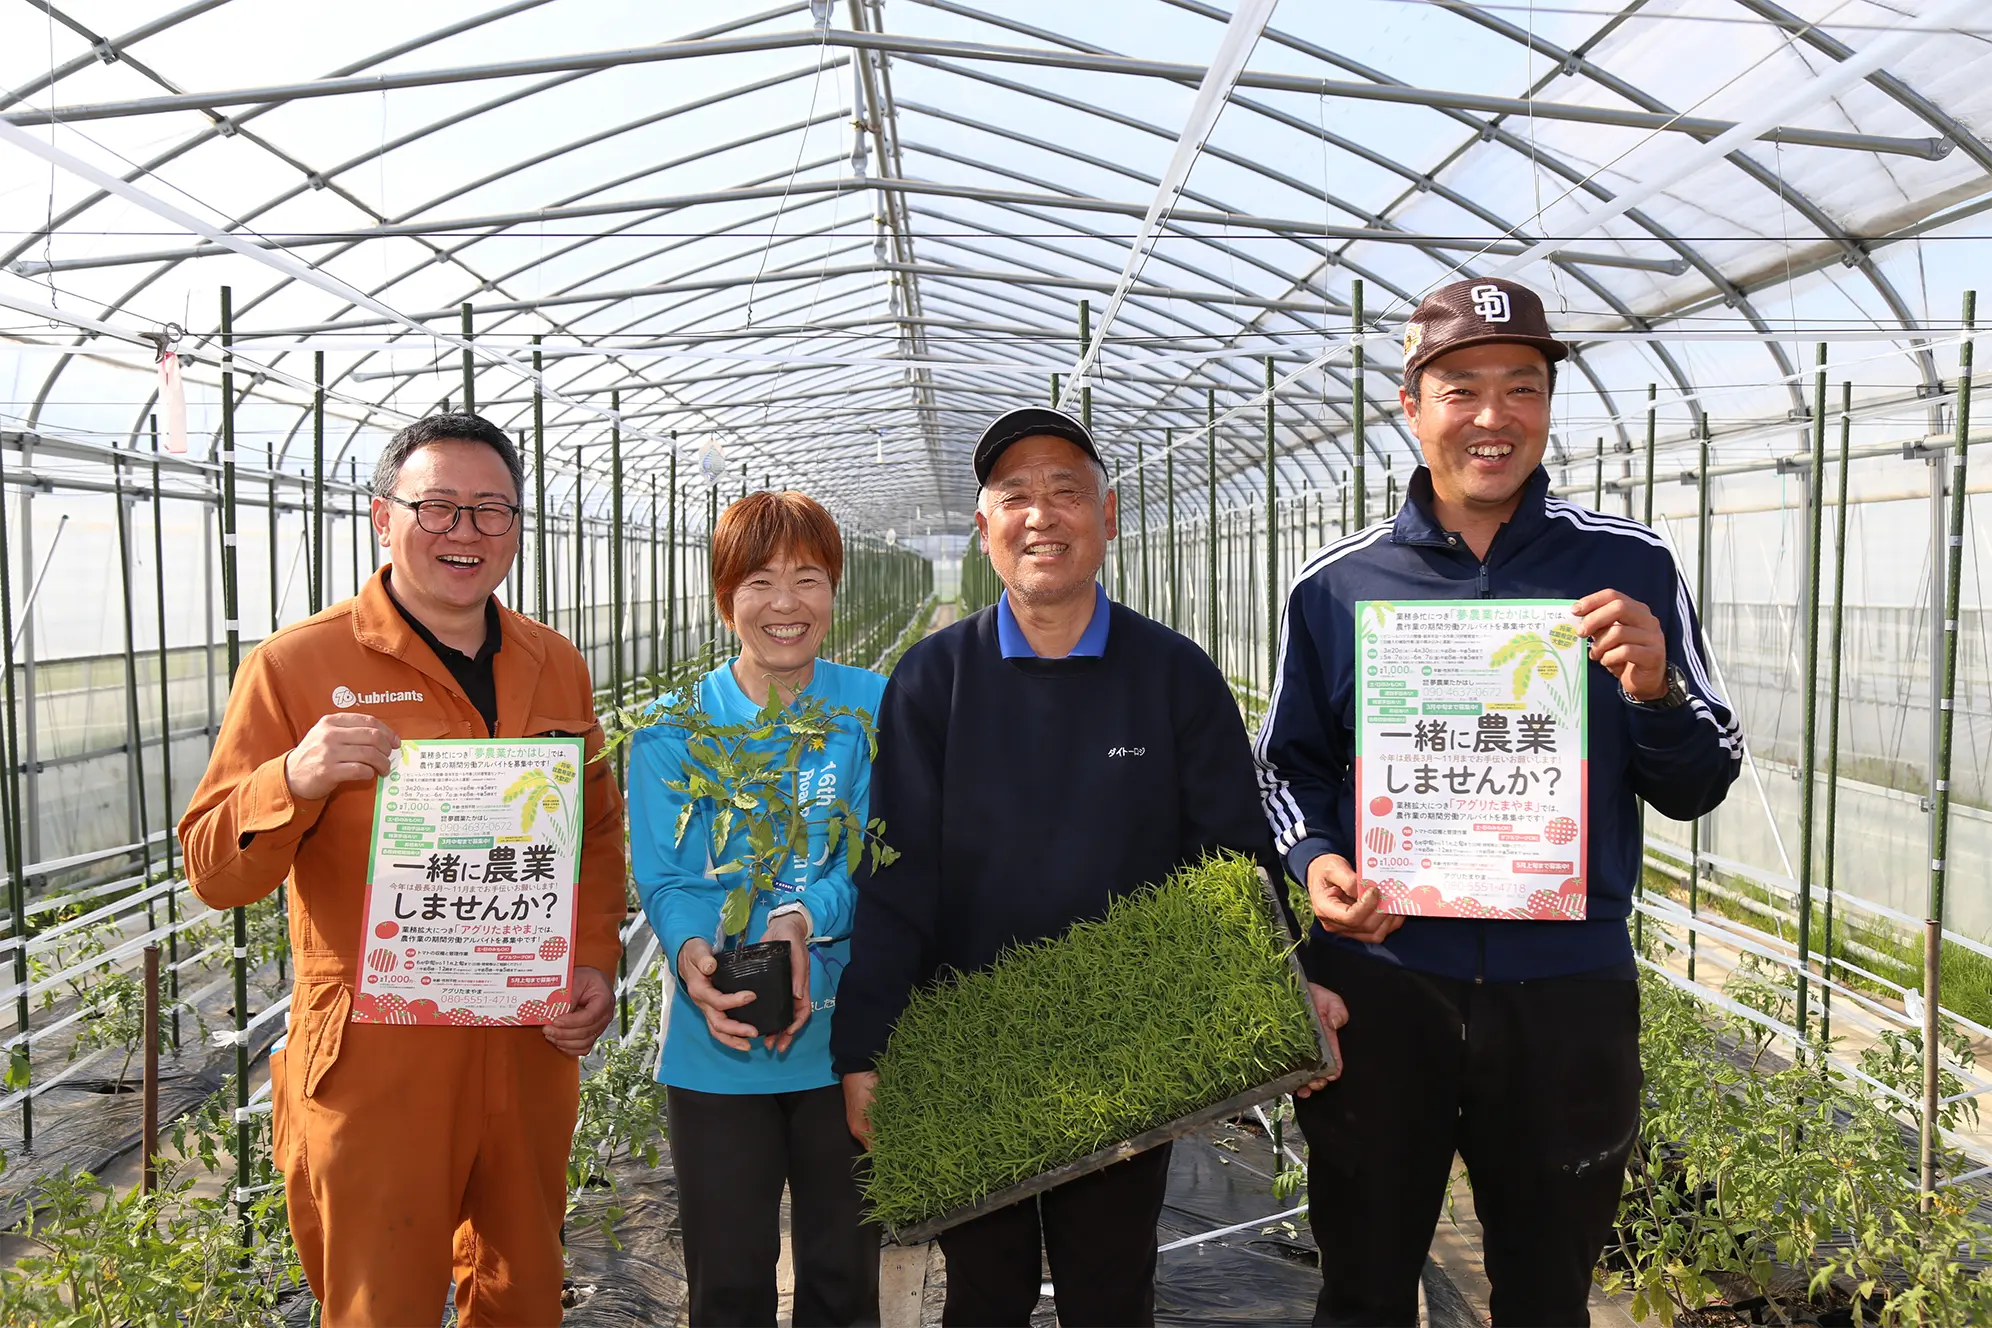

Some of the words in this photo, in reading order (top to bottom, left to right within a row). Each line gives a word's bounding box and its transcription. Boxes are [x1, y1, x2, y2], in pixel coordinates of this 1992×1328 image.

[1471, 284, 1511, 323] SD
[357, 690, 424, 704] Lubricants
[1422, 687, 1501, 697] 090-4637-0672
[1380, 713, 1557, 754] 一緒に農業
[816, 761, 837, 807] 16th
[1387, 764, 1562, 796] しませんか？
[439, 821, 512, 833] 090-4637-0672
[393, 844, 557, 884] 一緒に農業
[394, 892, 558, 921] しませんか？
[440, 994, 518, 1005] 080-5551-4718
